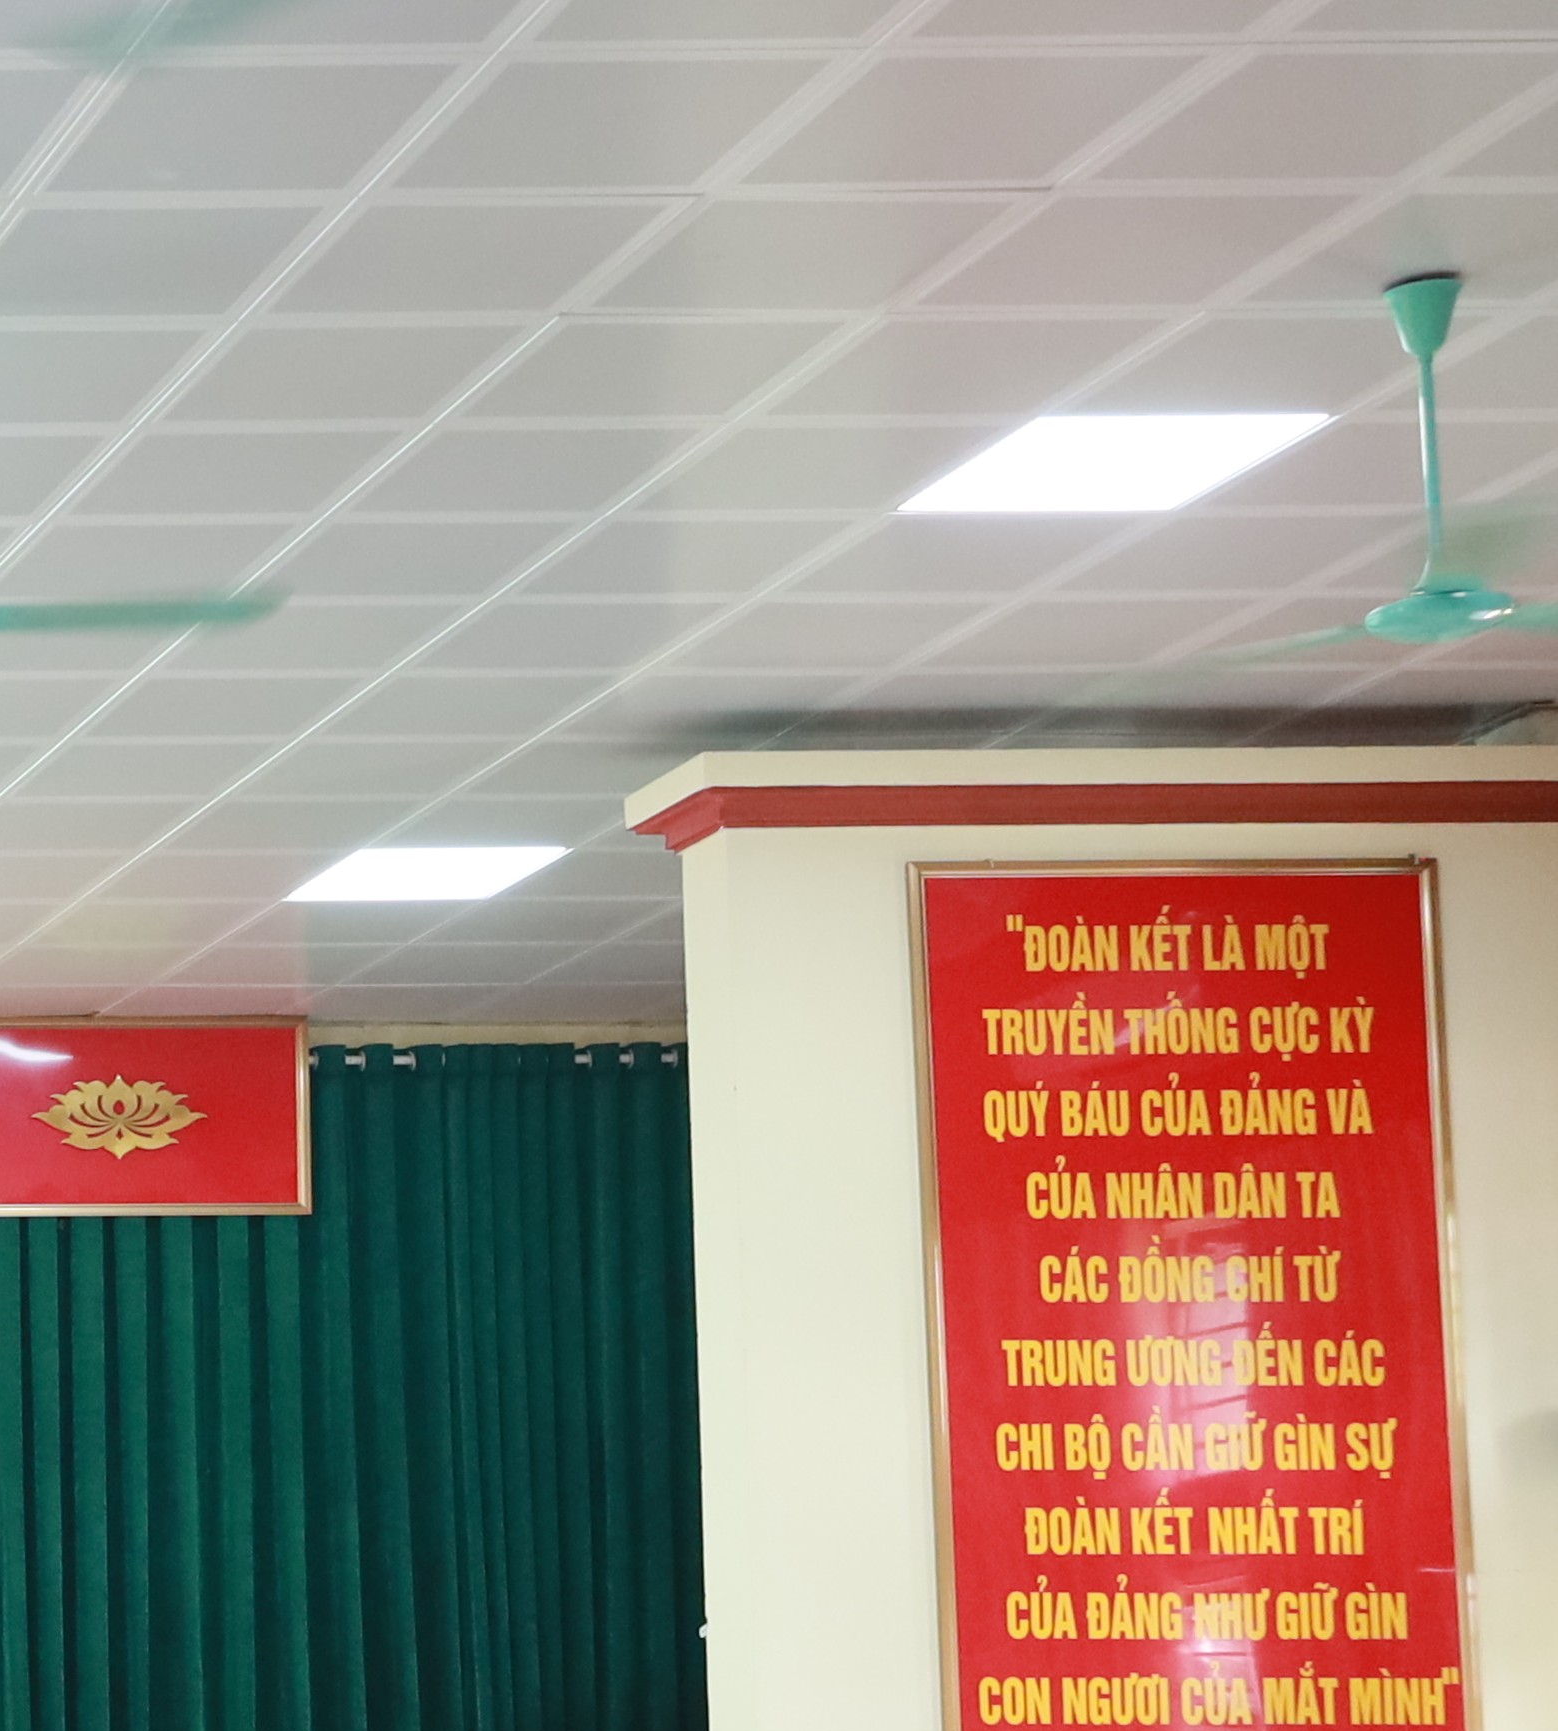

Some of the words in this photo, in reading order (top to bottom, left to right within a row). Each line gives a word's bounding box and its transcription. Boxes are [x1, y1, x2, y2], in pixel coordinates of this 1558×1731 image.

[1008, 916, 1119, 972] "ĐOÀN
[1130, 905, 1192, 970] KẾT
[1204, 916, 1245, 970] LÀ
[1256, 915, 1328, 977] MỘT
[983, 994, 1115, 1055] TRUYỀN
[1124, 991, 1240, 1054] THỐNG
[1250, 1003, 1320, 1060] CỰC
[1330, 996, 1374, 1052] KỲ
[984, 1080, 1049, 1141] QUÝ
[1060, 1081, 1131, 1136] BÁU
[1141, 1074, 1212, 1136] CỦA
[1221, 1072, 1318, 1135] ĐẢNG
[1327, 1079, 1374, 1134] VÀ
[1026, 1156, 1098, 1219] CỦA
[1106, 1164, 1204, 1218] NHÂN
[1214, 1164, 1287, 1218] DÂN
[1296, 1172, 1341, 1217] TA
[1040, 1248, 1109, 1302] CÁC
[1119, 1236, 1215, 1302] ĐỒNG
[1228, 1248, 1284, 1301] CHÍ
[1294, 1248, 1342, 1302] TỪ
[1001, 1340, 1117, 1386] TRUNG
[1128, 1337, 1221, 1384] ƯƠNG
[1235, 1321, 1304, 1385] ĐẾN
[1315, 1333, 1386, 1386] CÁC
[996, 1424, 1055, 1470] CHI
[1064, 1415, 1112, 1479] BỘ
[1123, 1406, 1193, 1470] CẦN
[1208, 1413, 1267, 1470] GIỮ
[1274, 1415, 1337, 1470] GÌN
[1346, 1418, 1398, 1478] SỰ
[1025, 1498, 1122, 1555] ĐOÀN
[1131, 1487, 1194, 1554] KẾT
[1209, 1488, 1300, 1554] NHẤT
[1308, 1499, 1365, 1554] TRÍ
[1007, 1576, 1079, 1639] CỦA
[1086, 1575, 1183, 1639] ĐẢNG
[1194, 1589, 1271, 1639] NHƯ
[1276, 1583, 1339, 1640] GIỮ
[1345, 1584, 1408, 1639] GÌN
[979, 1677, 1052, 1724] CON
[1062, 1674, 1170, 1725] NGƯƠI
[1183, 1661, 1252, 1724] CỦA
[1263, 1661, 1339, 1724] MẮT
[1349, 1668, 1465, 1724] MÌNH"
